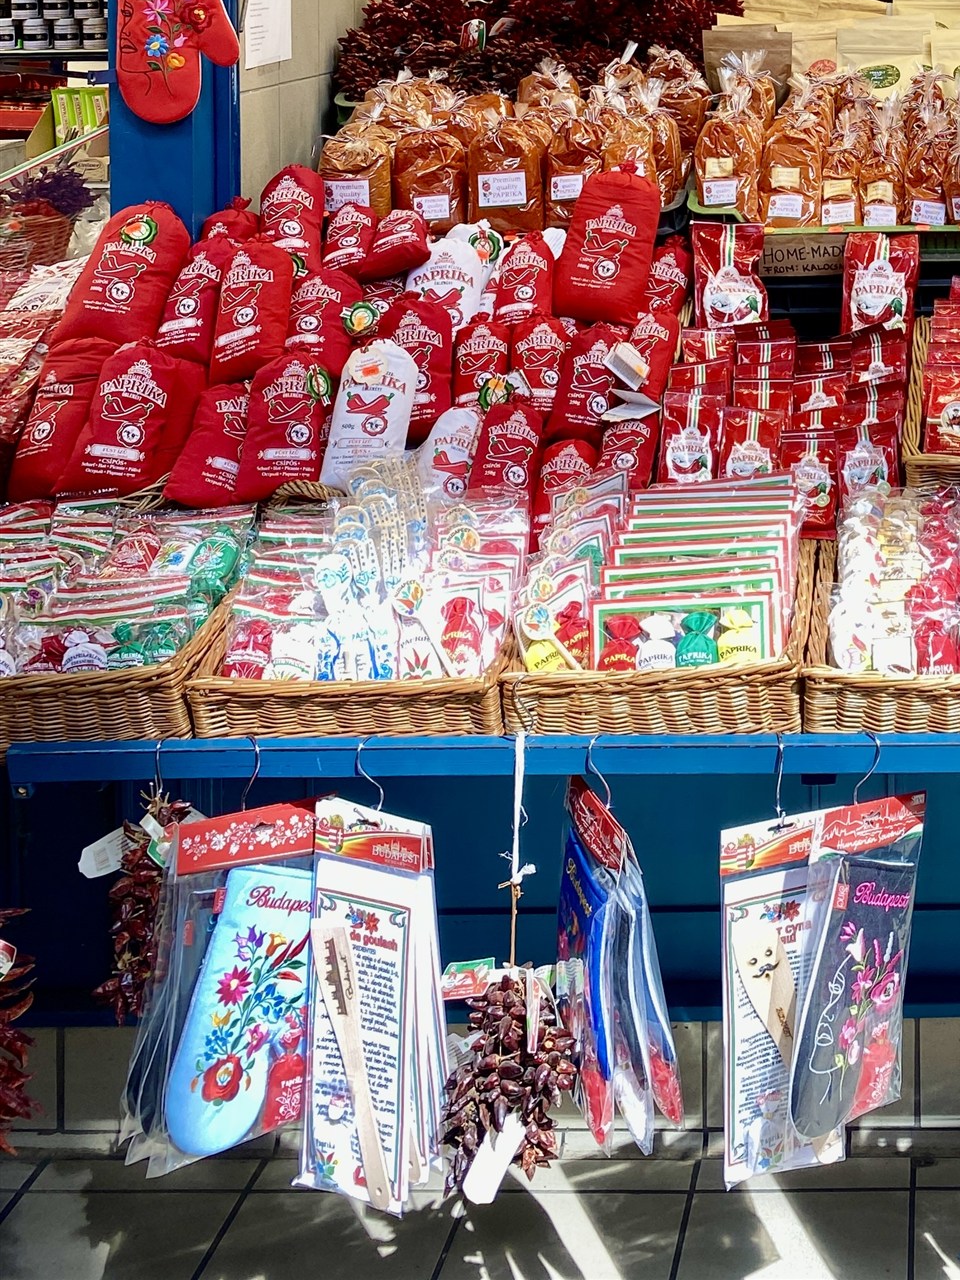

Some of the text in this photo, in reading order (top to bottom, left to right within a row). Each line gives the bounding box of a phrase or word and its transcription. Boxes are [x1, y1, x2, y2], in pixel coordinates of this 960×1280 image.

[339, 190, 361, 198] quality
[496, 183, 518, 191] quality
[585, 219, 637, 237] PAPRIKA
[412, 269, 475, 289] PAPRIKA
[854, 285, 904, 297] PAPRIKA
[456, 340, 508, 359] PAPRIKA
[100, 377, 168, 409] PAPRIKA
[489, 425, 540, 447] PAPRIKA
[670, 444, 710, 454] PAPRIKA
[730, 455, 770, 465] PAPRIKA
[847, 458, 886, 470] PAPRIKA
[638, 653, 674, 667] PAPRIKA
[678, 652, 713, 663] PAPRIKA
[719, 645, 757, 660] PAPRIKA
[836, 835, 876, 852] Hungarian
[371, 843, 420, 865] BUDAPEST
[246, 885, 313, 917] Budapes
[853, 881, 911, 913] Budapest
[349, 929, 361, 941] de
[362, 933, 398, 952] goulash
